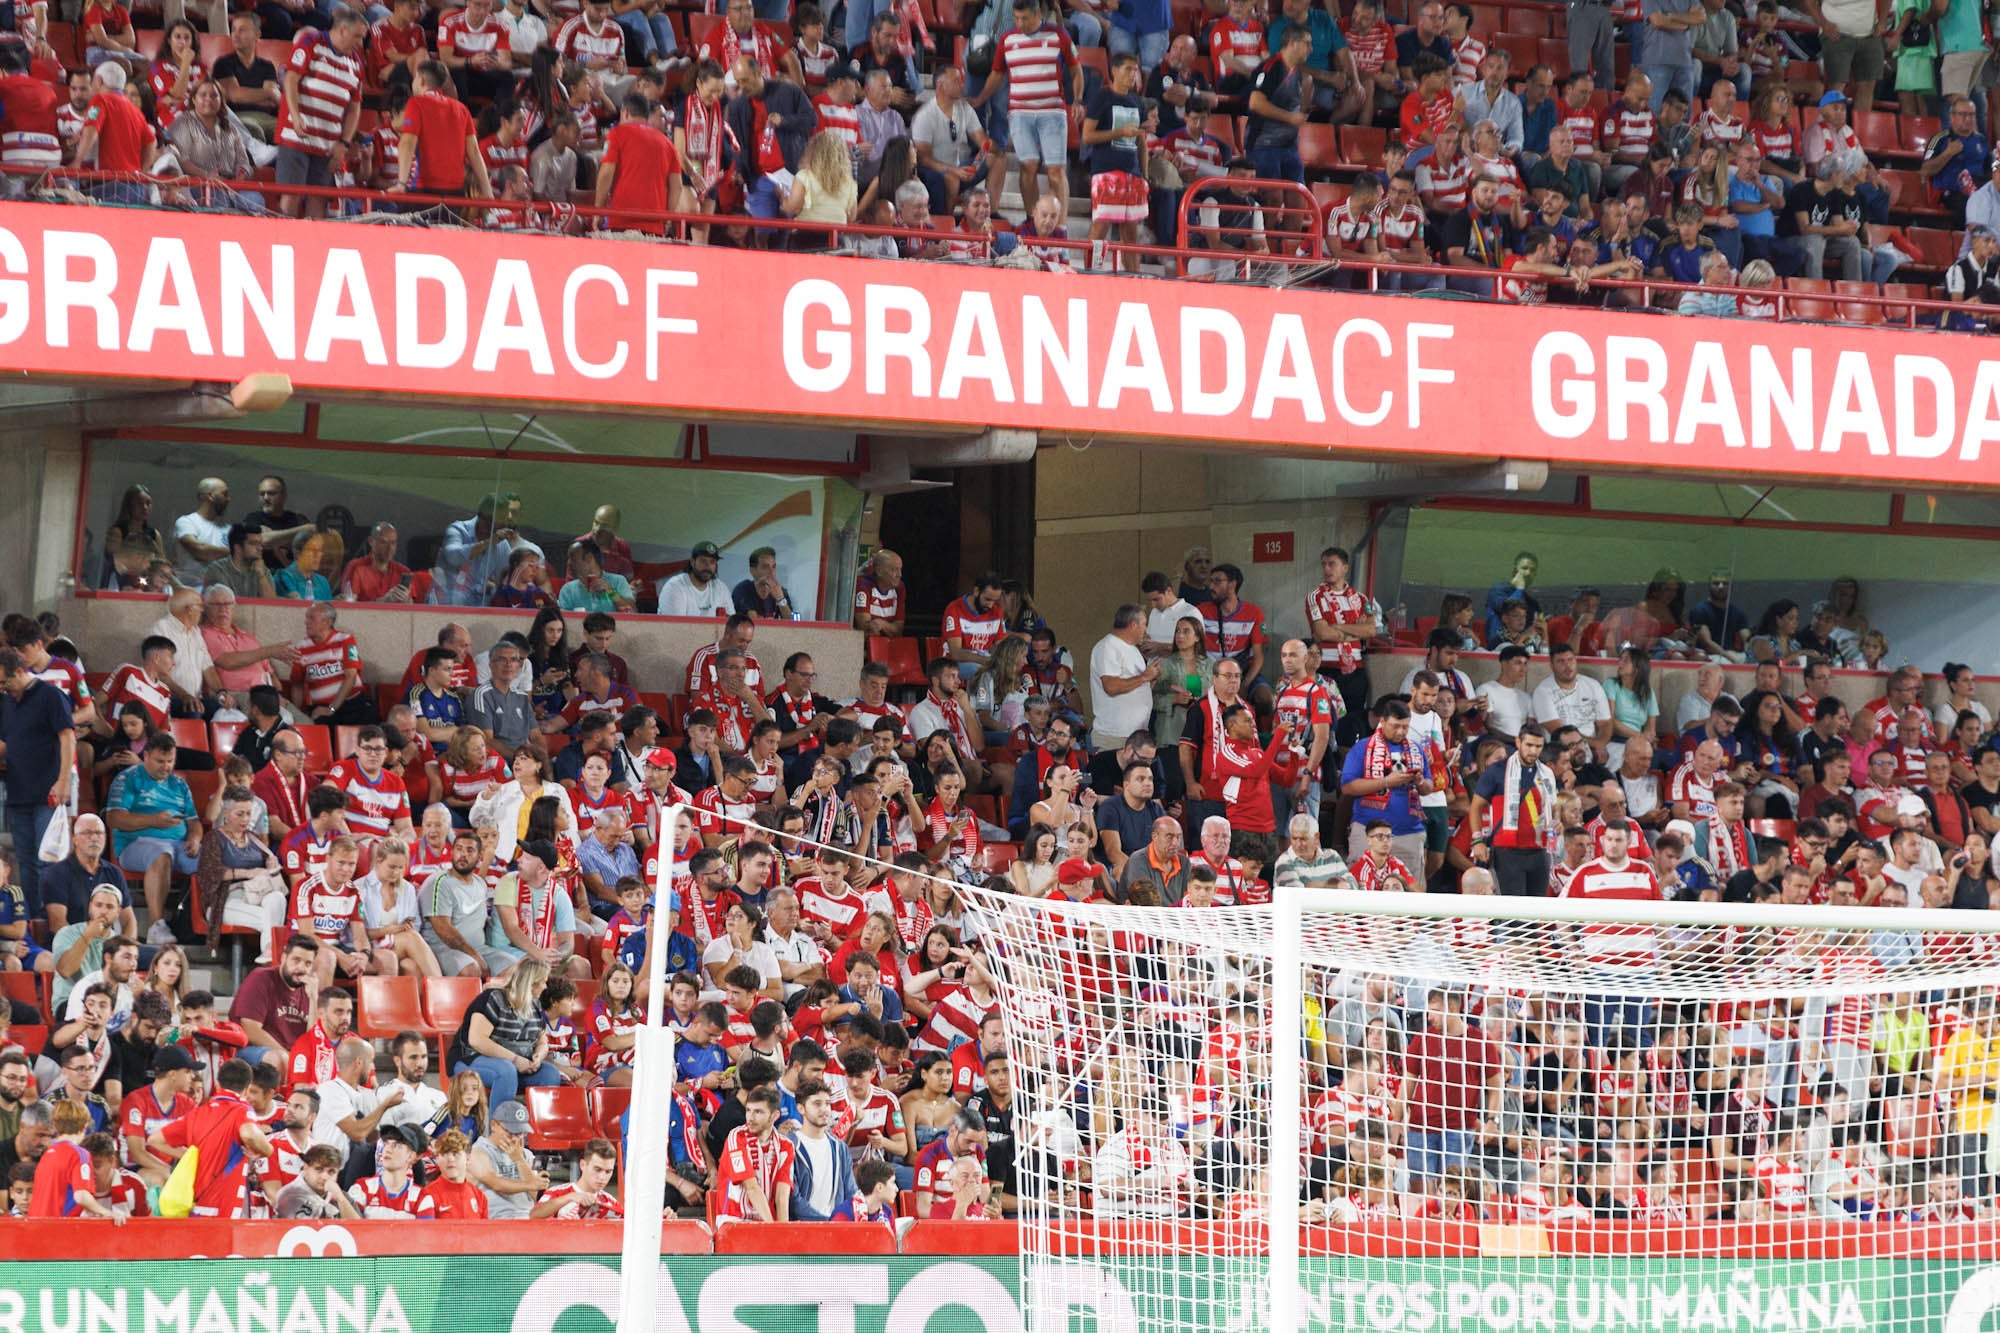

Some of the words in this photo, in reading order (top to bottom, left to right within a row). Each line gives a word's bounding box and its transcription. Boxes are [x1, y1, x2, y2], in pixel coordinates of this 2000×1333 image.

[1265, 541, 1281, 553] 135
[40, 1287, 128, 1333] UN
[143, 1271, 414, 1333] MAÑANA
[1447, 1281, 1556, 1330] POR
[1566, 1281, 1638, 1330] UN
[1651, 1269, 1868, 1329] MAÑANA
